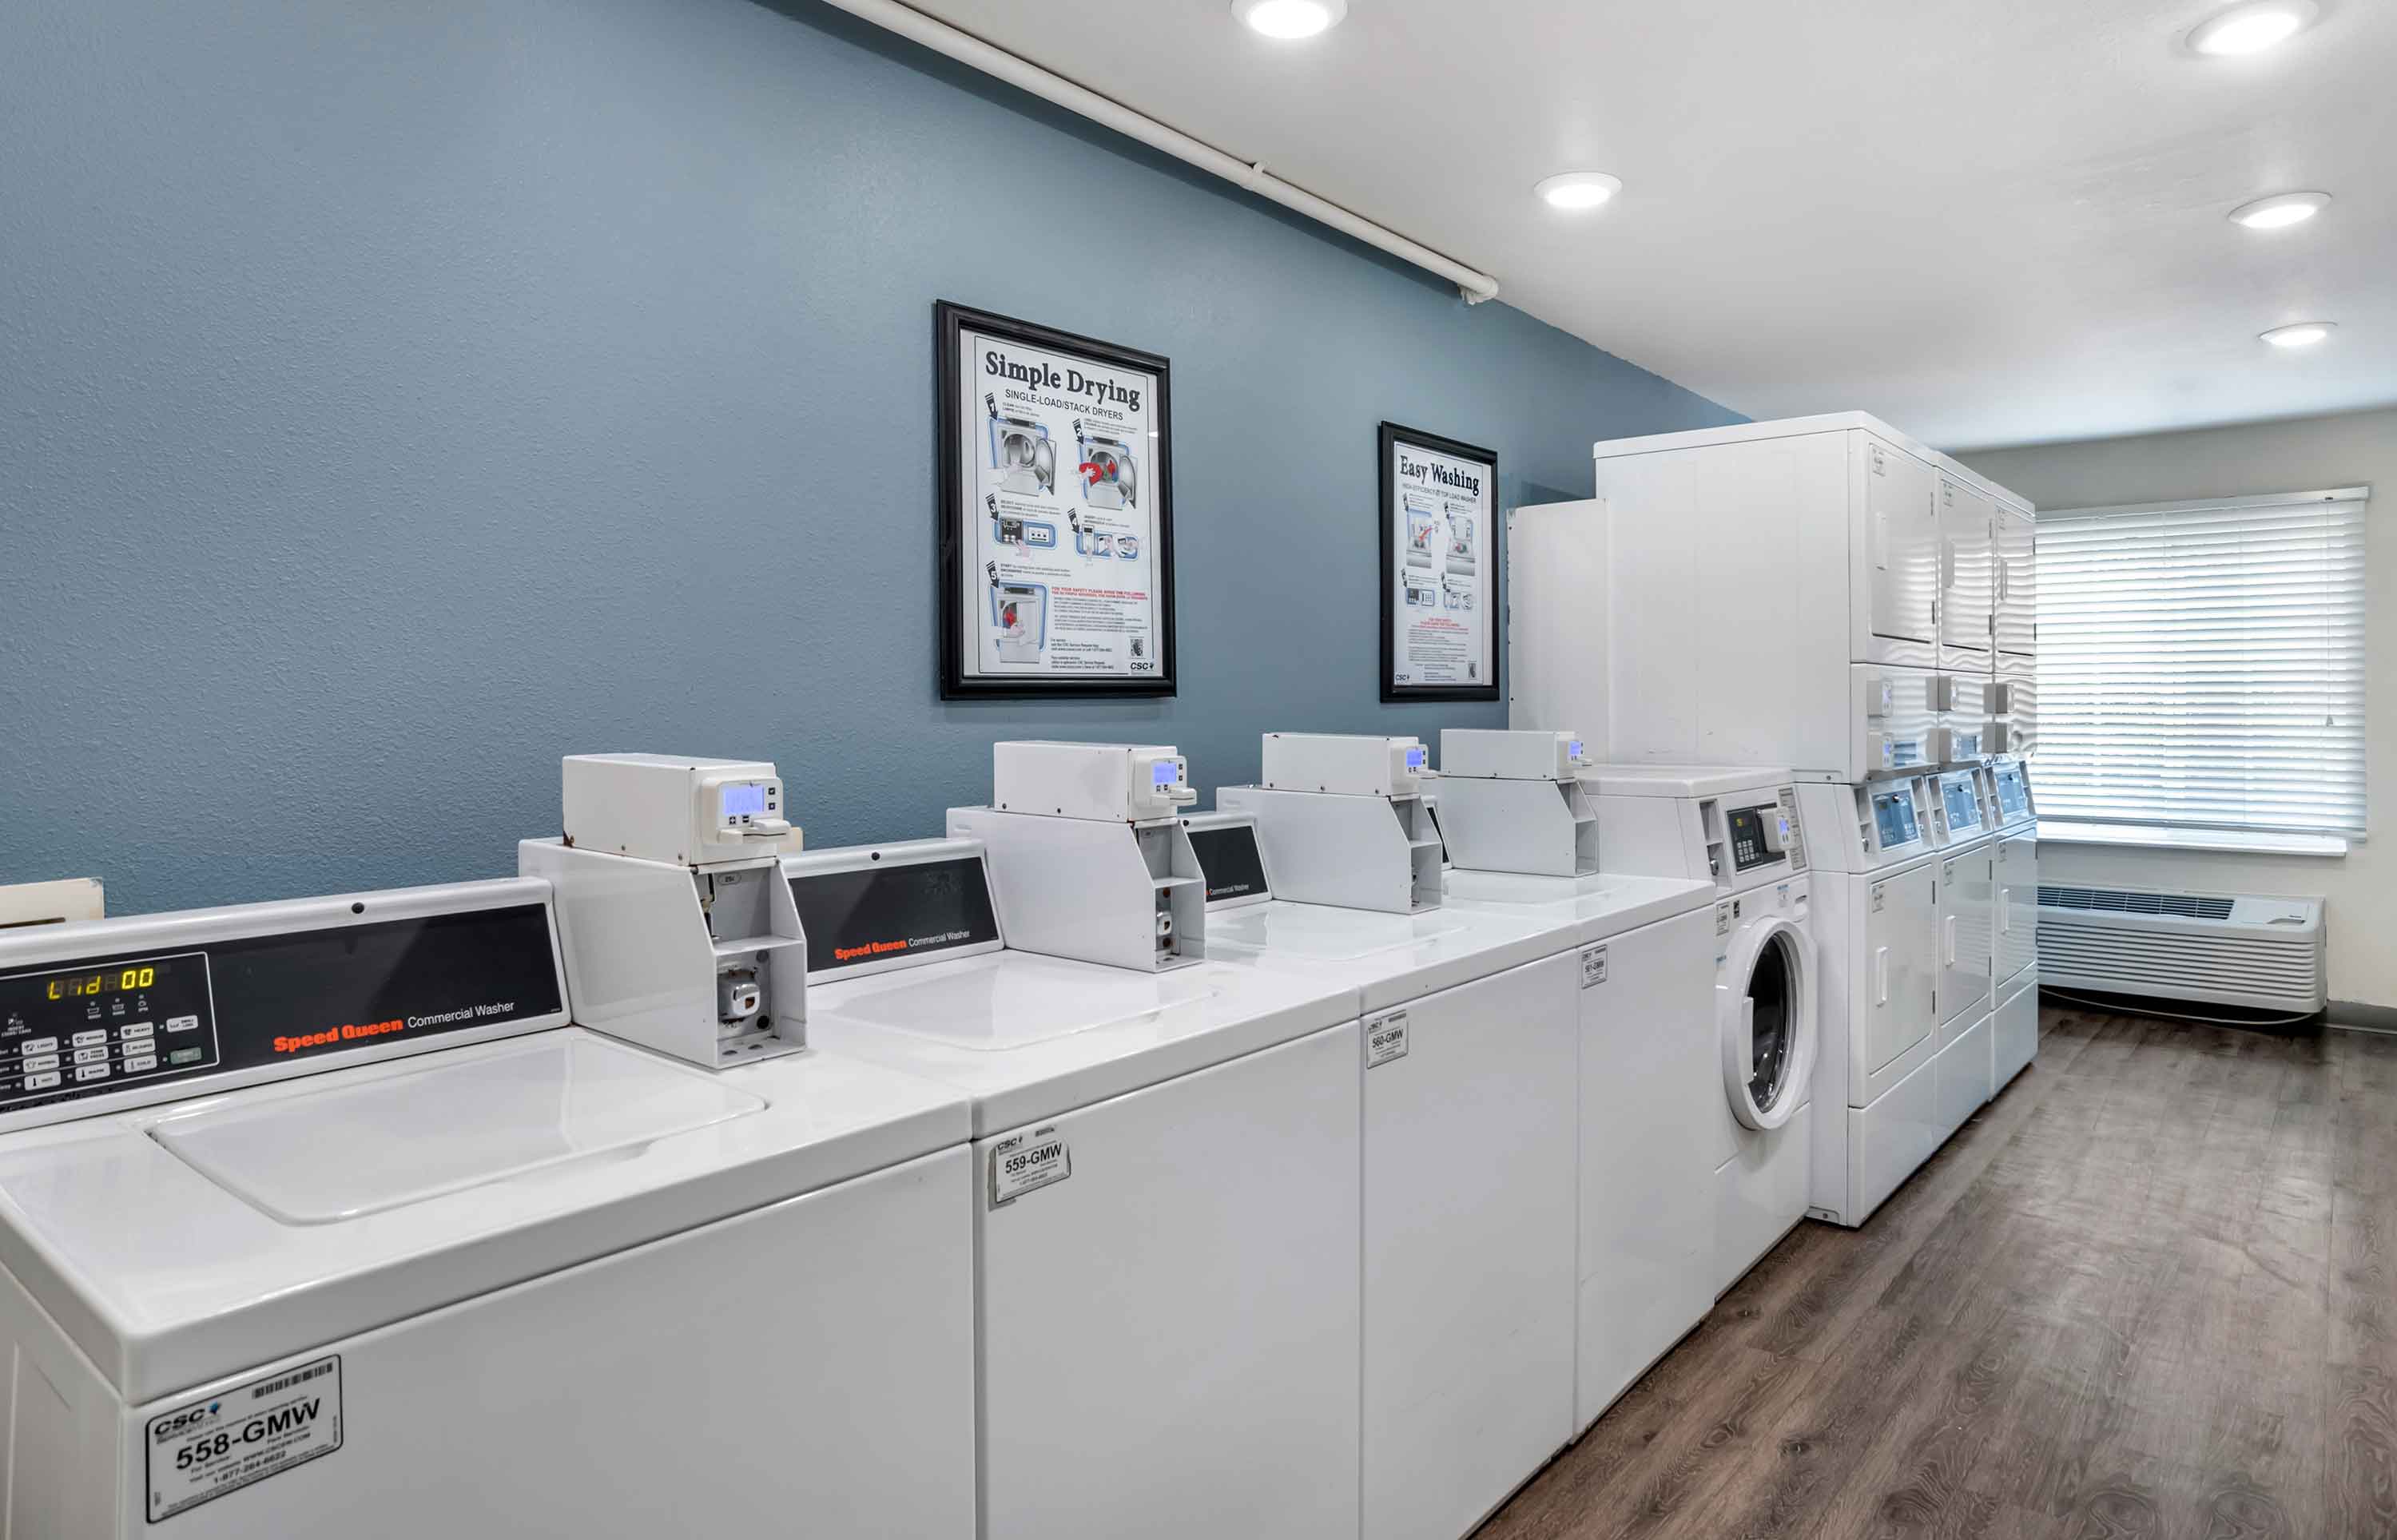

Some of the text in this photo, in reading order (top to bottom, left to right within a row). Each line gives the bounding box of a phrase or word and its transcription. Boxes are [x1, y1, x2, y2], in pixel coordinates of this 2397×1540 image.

[985, 351, 1140, 411] Simple Drying
[1005, 388, 1091, 414] SINGLE-LOAD/STACK
[1092, 407, 1123, 420] DRYERS
[1400, 455, 1479, 496] Easy Washing
[834, 930, 970, 961] Speed Queen Commercial Washer
[121, 967, 154, 990] 00
[273, 1001, 515, 1053] Speed Queen Commercial Washer
[997, 1137, 1017, 1151] CSC
[1005, 1142, 1062, 1173] 559-GMW
[154, 1408, 205, 1435] CSC
[177, 1397, 320, 1469] 558-GMW
